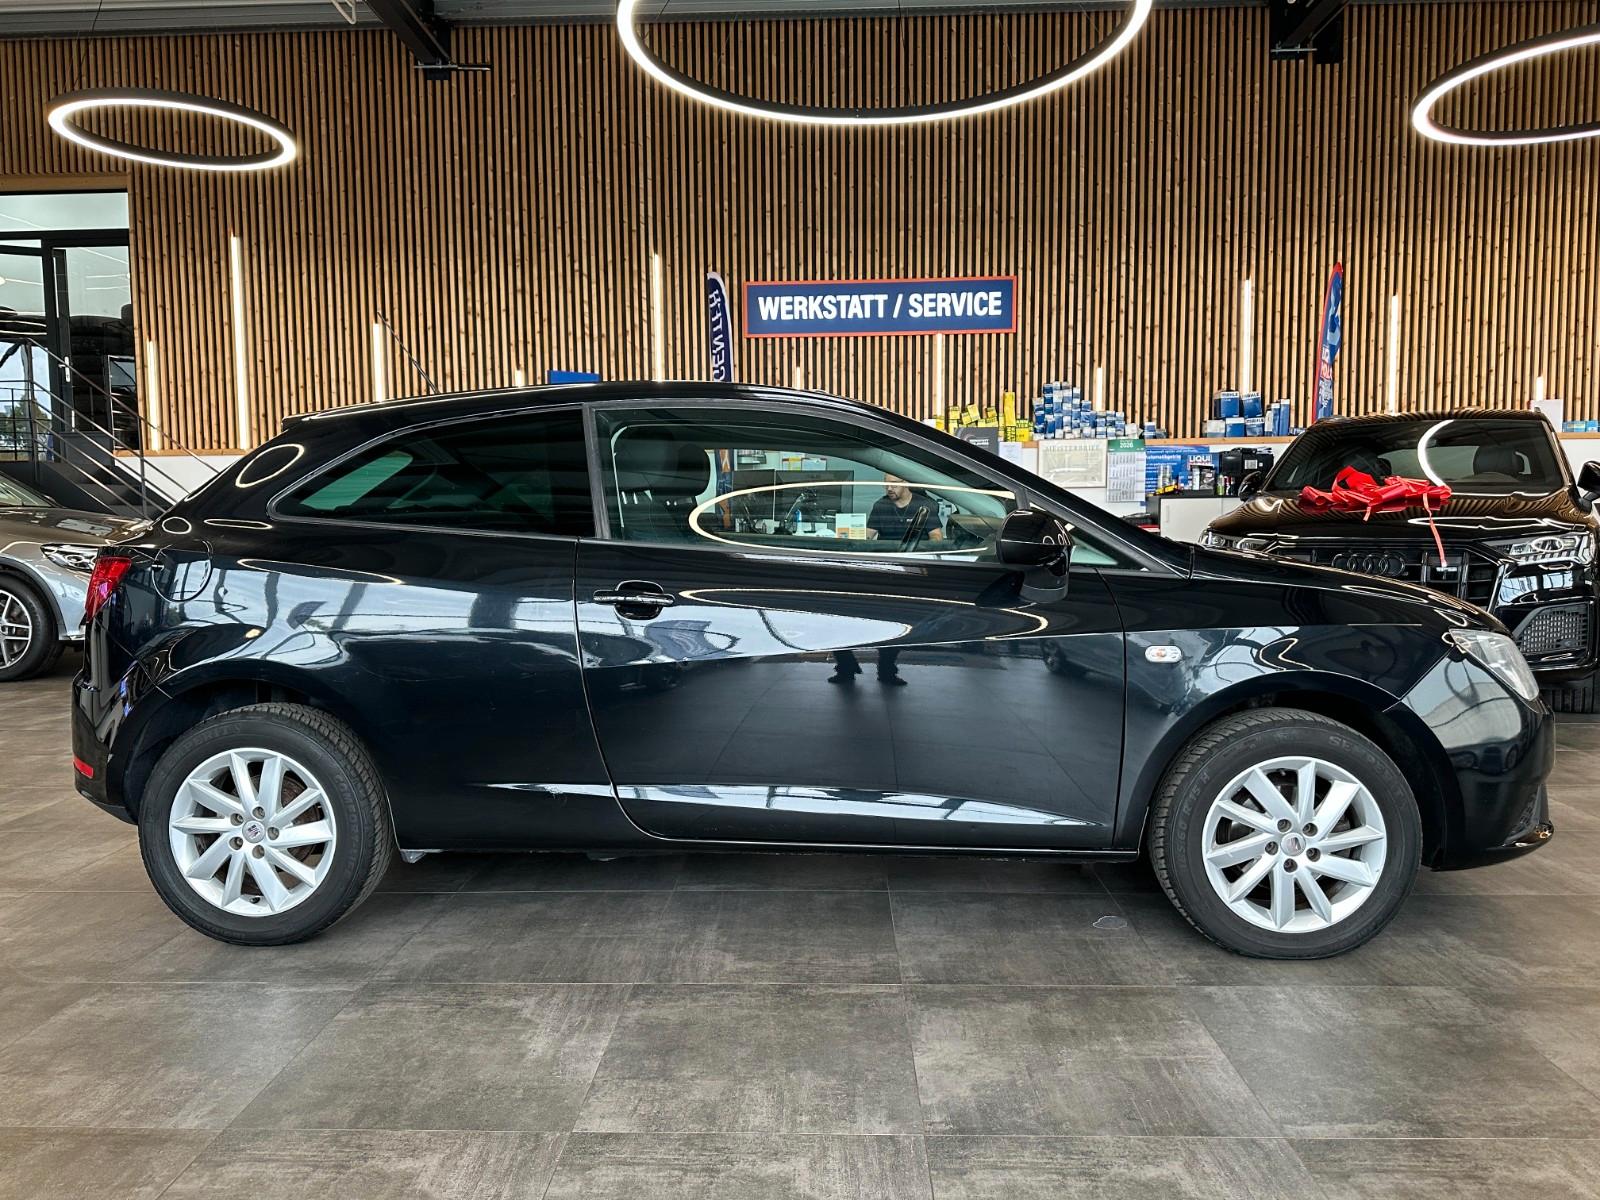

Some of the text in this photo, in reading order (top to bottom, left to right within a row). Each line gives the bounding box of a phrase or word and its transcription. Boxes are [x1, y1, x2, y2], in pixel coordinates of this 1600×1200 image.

[758, 292, 1002, 320] WERKSTATT / SERVICE
